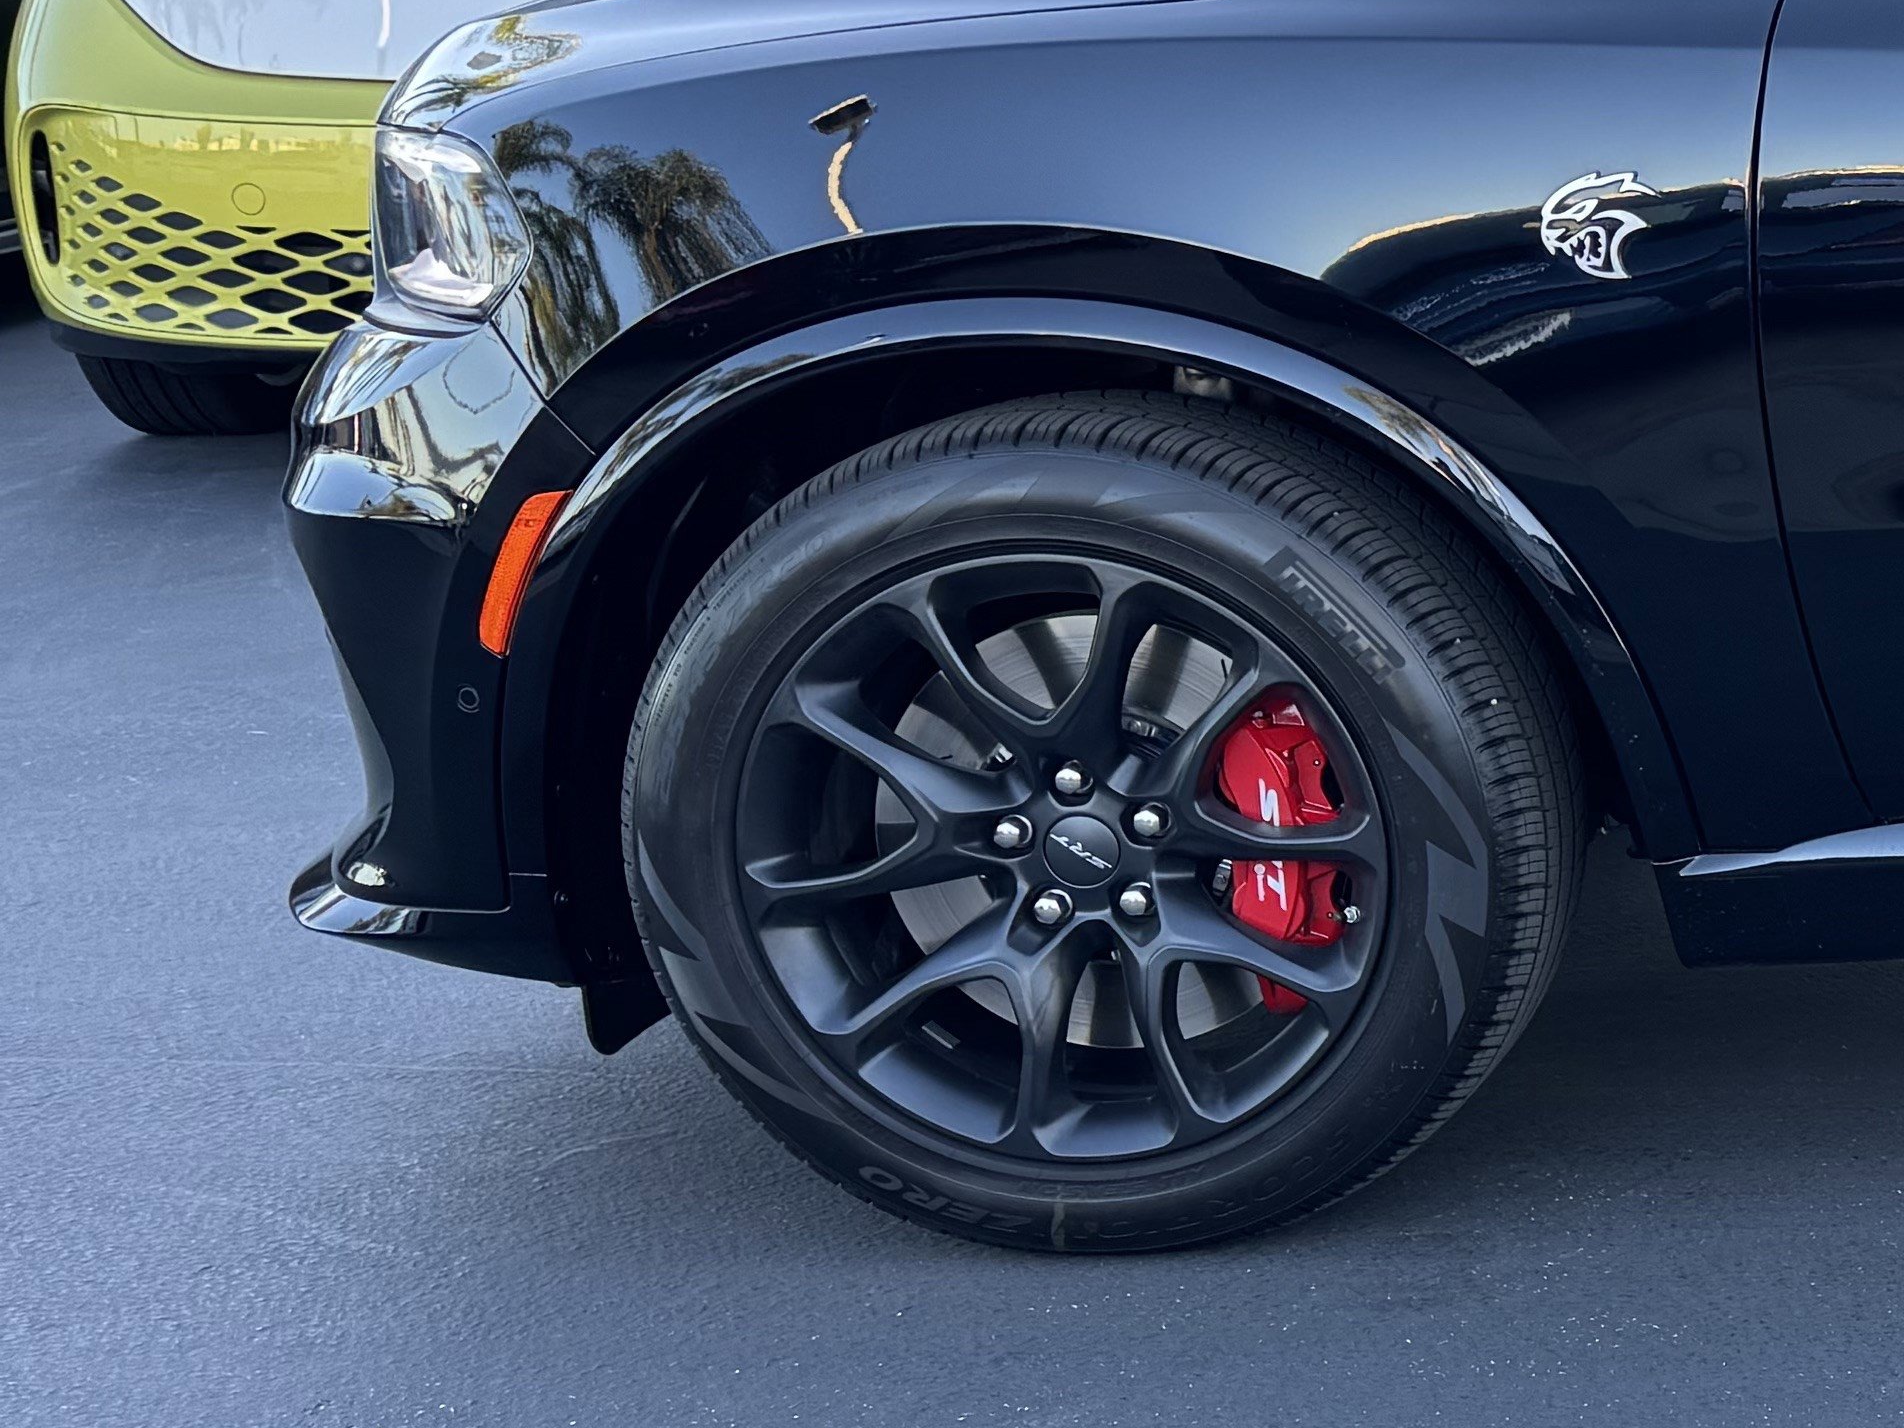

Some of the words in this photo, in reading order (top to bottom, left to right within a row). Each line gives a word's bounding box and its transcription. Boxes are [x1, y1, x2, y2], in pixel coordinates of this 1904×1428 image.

[1263, 545, 1406, 686] PIRELLI
[1049, 833, 1113, 870] SRT
[857, 1165, 1035, 1230] ZERO
